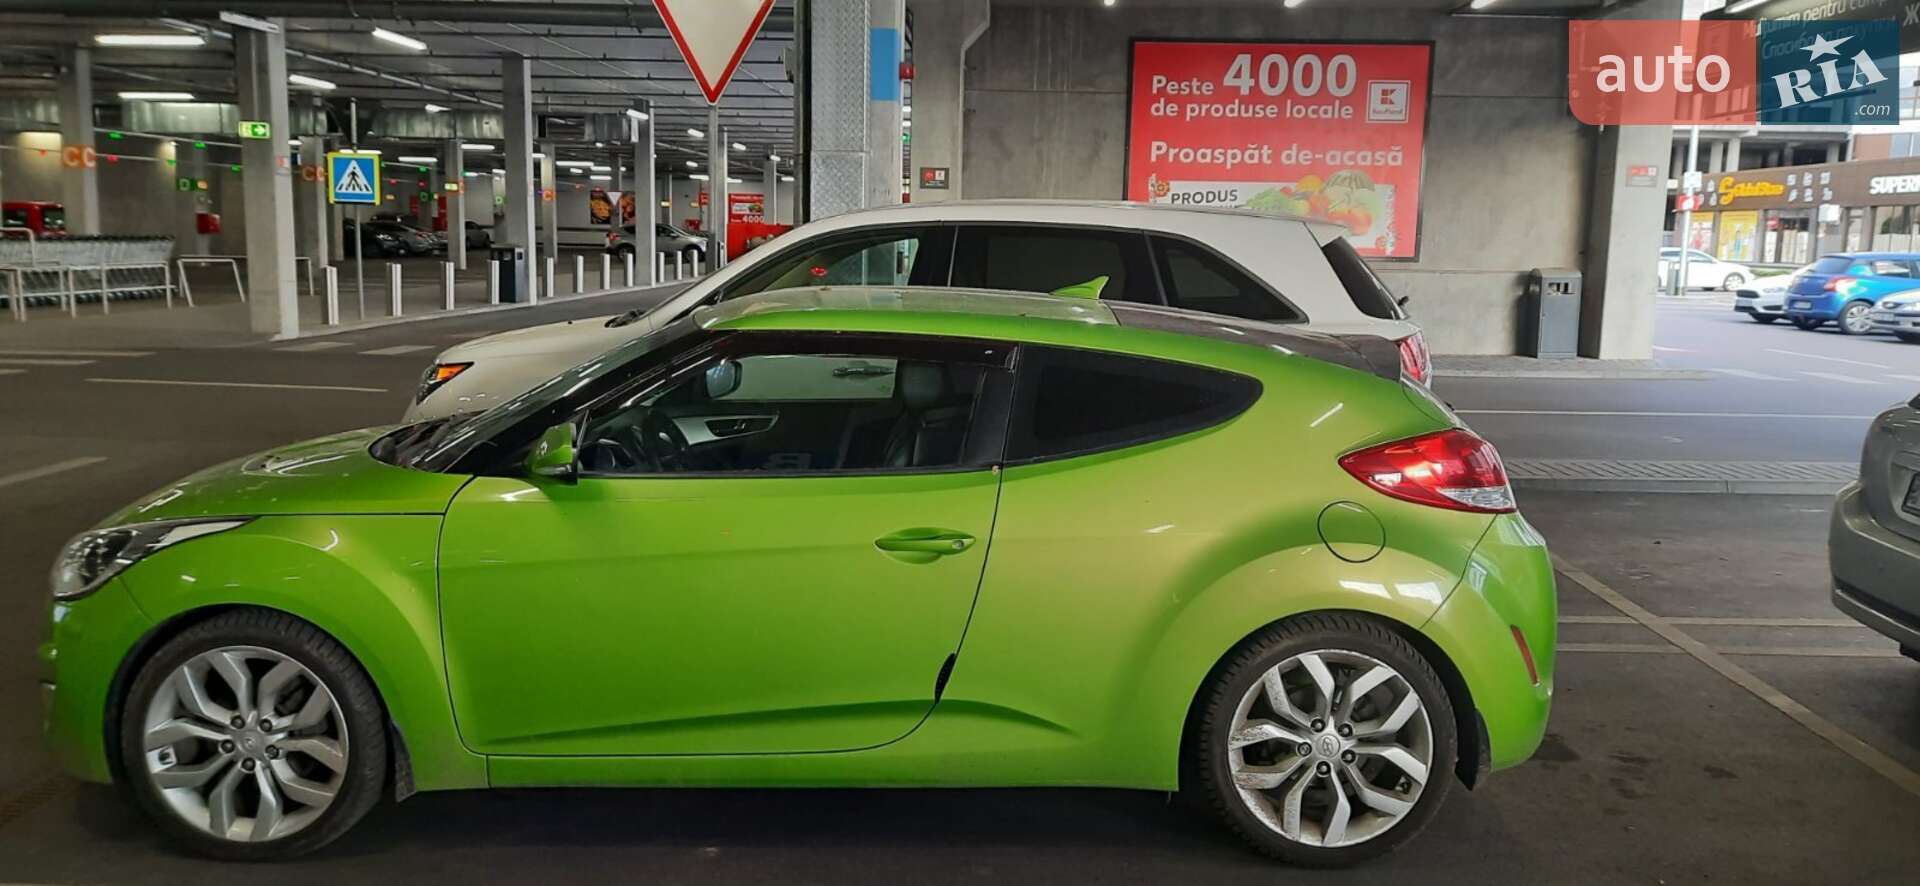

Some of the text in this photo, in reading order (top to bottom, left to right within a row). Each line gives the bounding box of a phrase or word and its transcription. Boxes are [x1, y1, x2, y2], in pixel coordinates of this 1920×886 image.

[1803, 1, 1847, 28] pentru
[1152, 53, 1357, 97] Peste 4000
[1151, 98, 1354, 121] de produse locale
[1151, 141, 1403, 168] Proaspăt de-acasă
[1171, 189, 1238, 205] PRODUS
